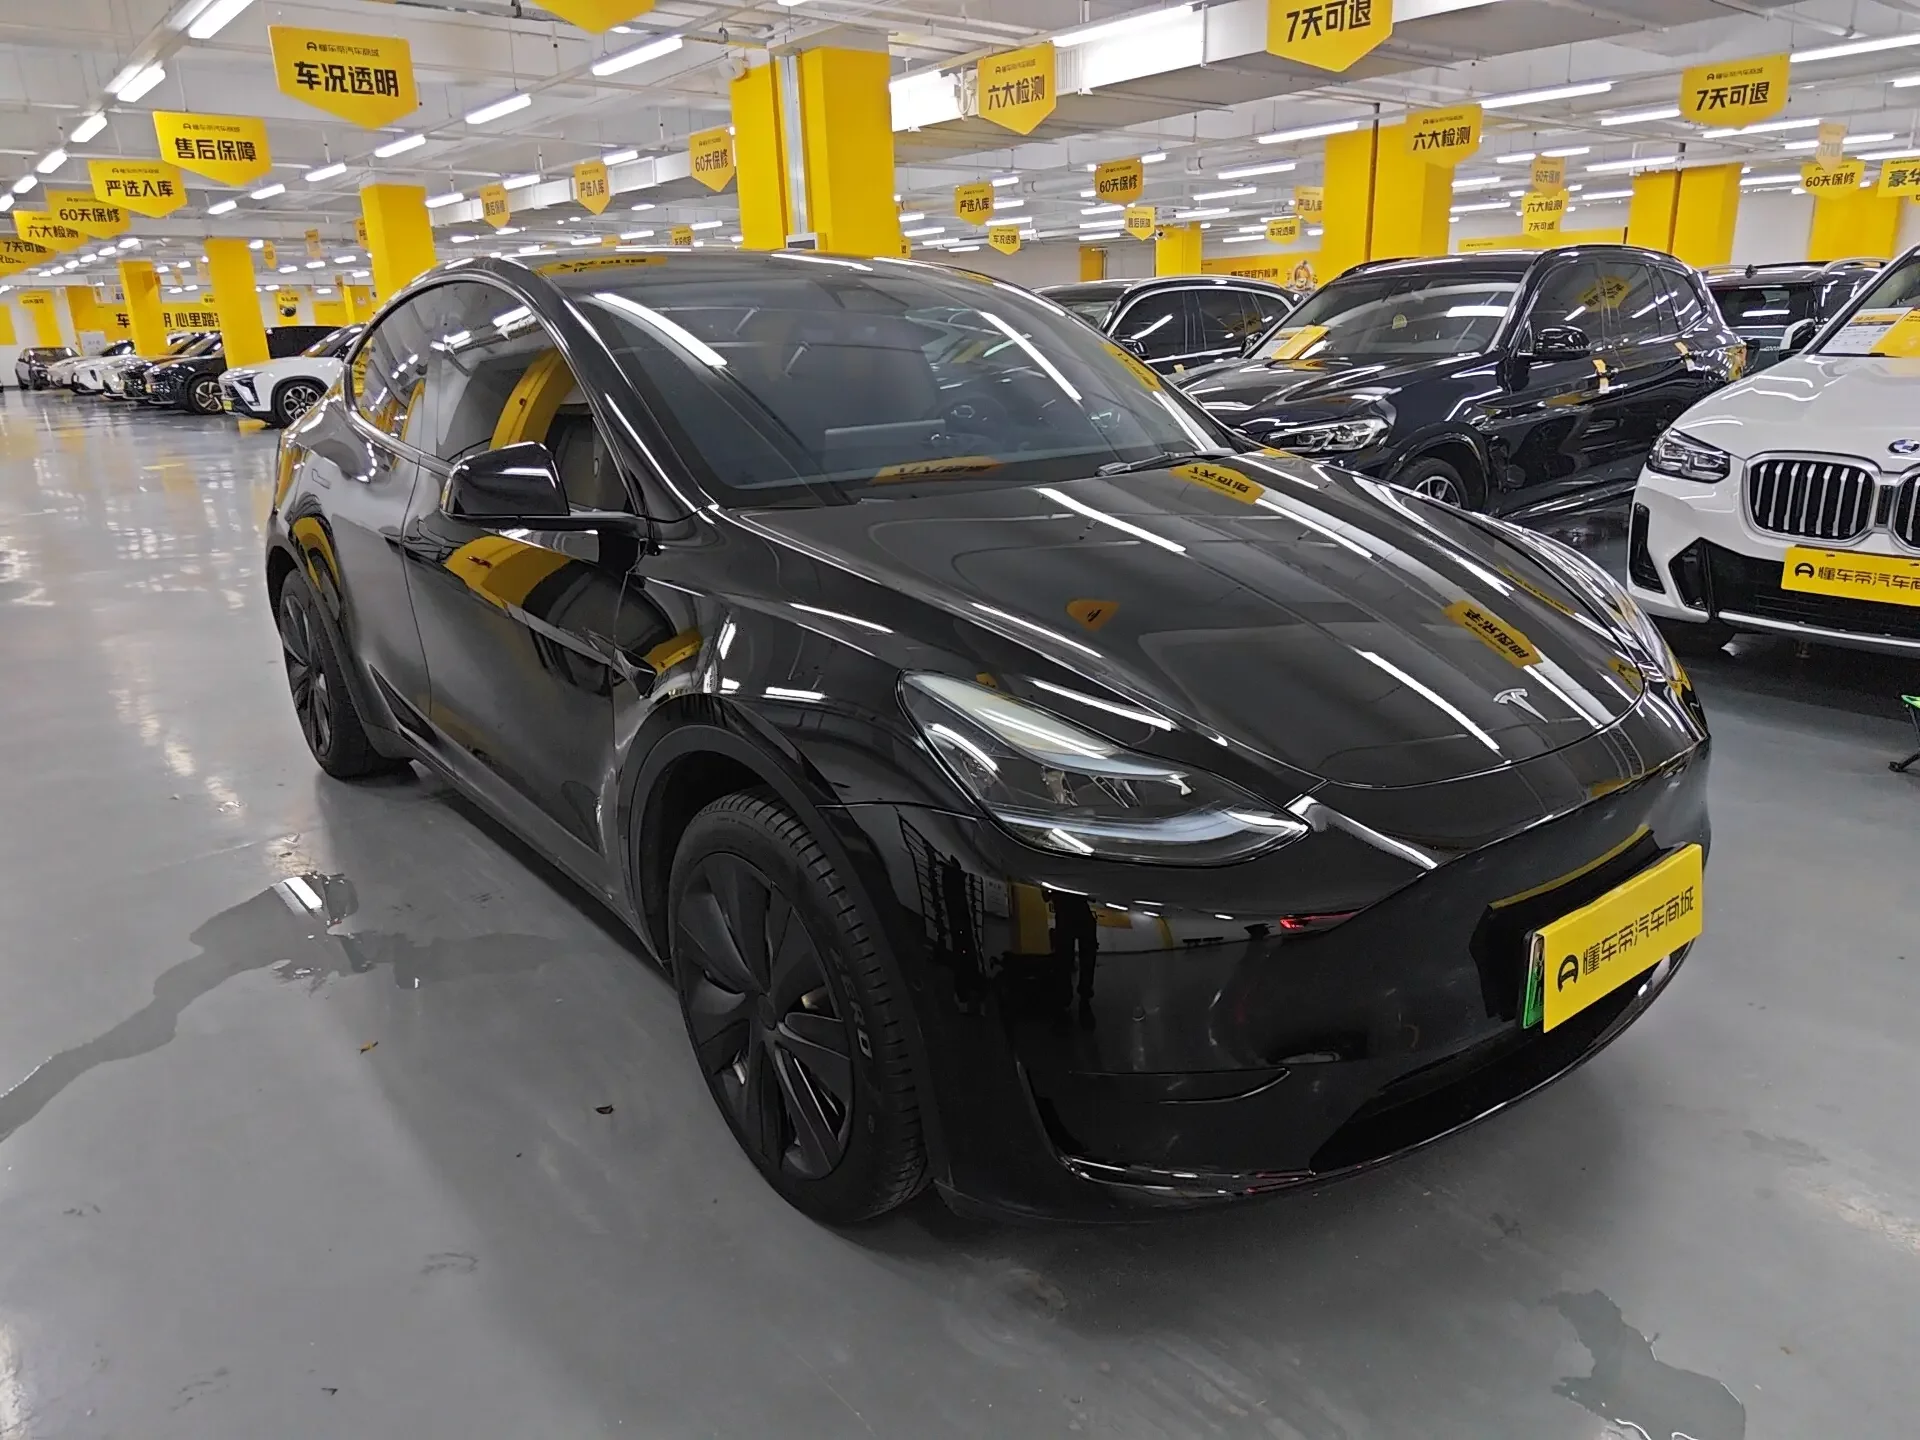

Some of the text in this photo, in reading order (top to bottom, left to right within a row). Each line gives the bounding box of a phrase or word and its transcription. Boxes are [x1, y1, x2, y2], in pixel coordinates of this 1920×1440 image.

[1286, 0, 1371, 43] 7天可退
[294, 61, 400, 98] 车况透明
[988, 73, 1045, 110] 六大检测
[1696, 81, 1770, 112] 7天可退
[175, 137, 258, 162] 售后保障
[1412, 125, 1472, 151] 六大检测
[695, 148, 729, 173] 60天保修
[104, 179, 175, 198] 严选入库
[1099, 174, 1138, 194] 60天保修
[1805, 172, 1856, 188] 60天保修
[59, 207, 121, 223] 60天保修
[959, 197, 990, 214] 严选入库
[1526, 199, 1563, 214] 六大检测
[27, 224, 79, 239] 六大检测
[1582, 885, 1694, 977] 懂车帝汽车商城
